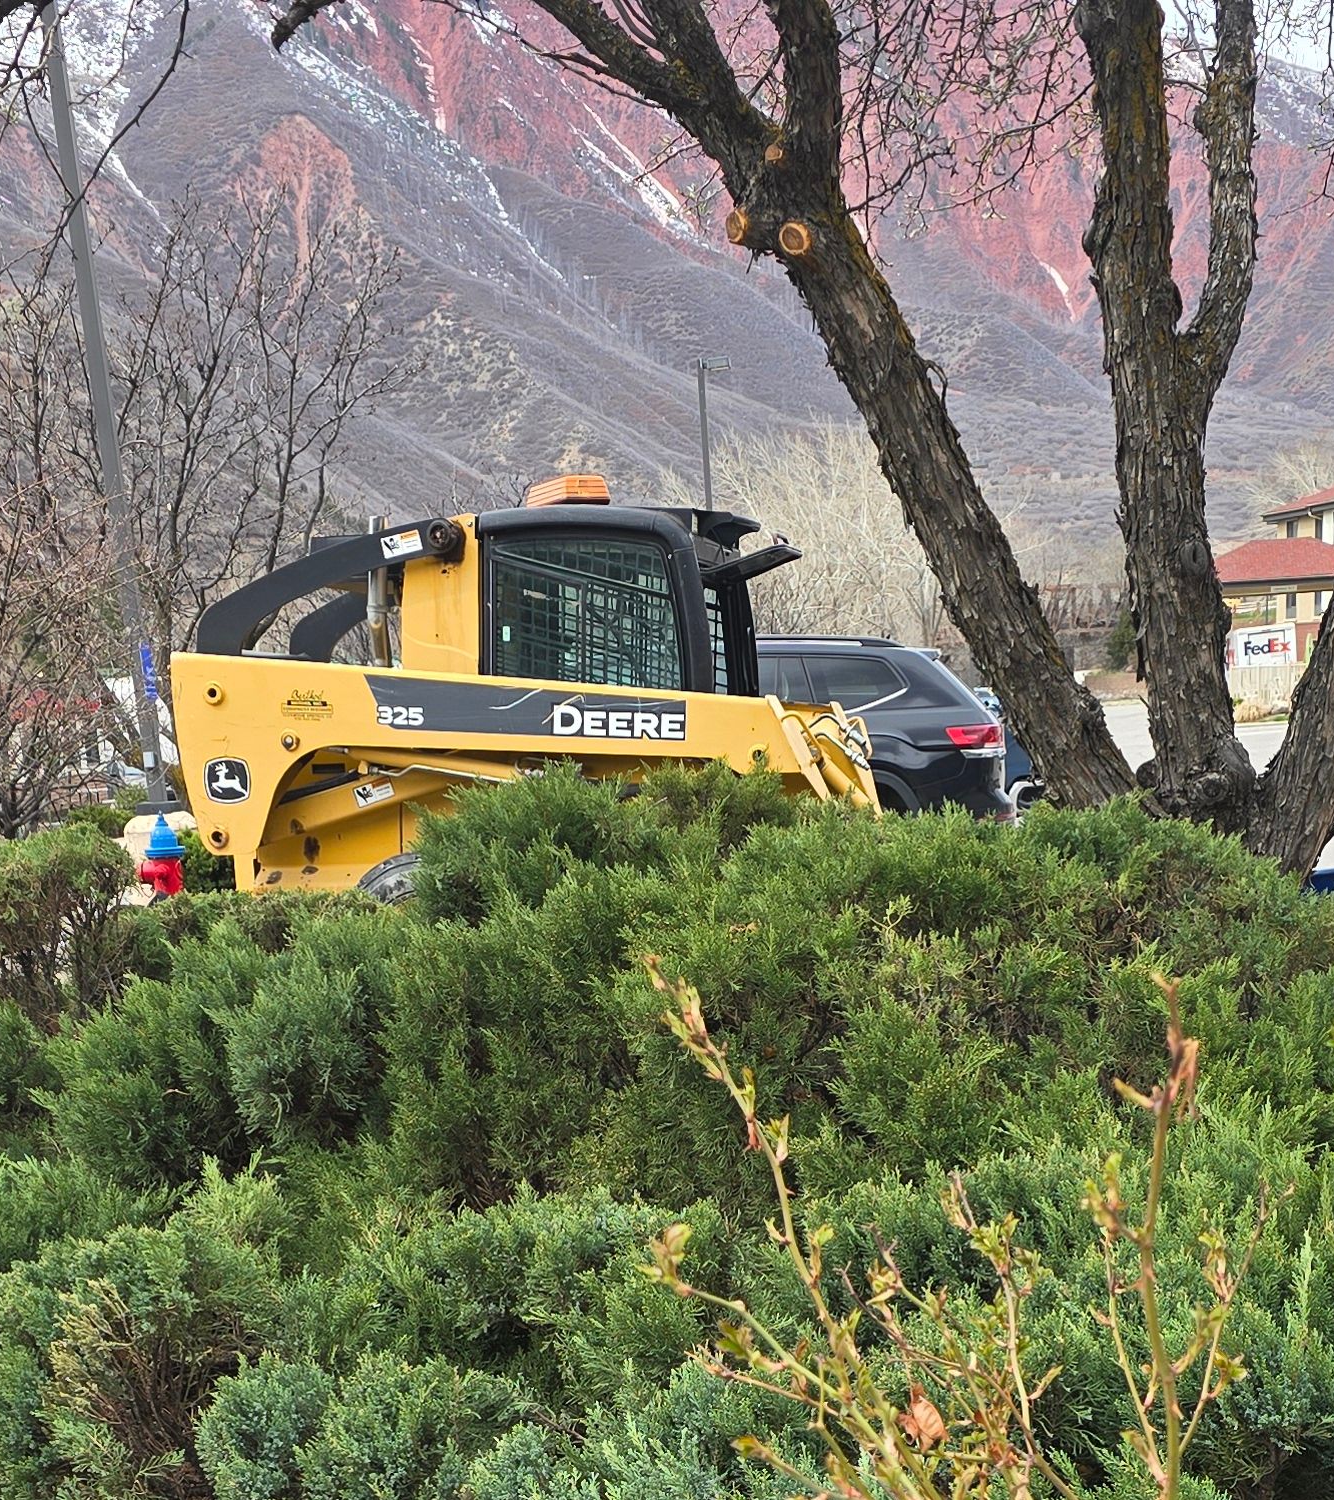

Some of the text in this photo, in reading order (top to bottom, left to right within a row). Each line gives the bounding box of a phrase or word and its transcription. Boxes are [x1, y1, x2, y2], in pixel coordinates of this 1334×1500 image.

[1243, 638, 1291, 656] FedEx
[377, 705, 425, 726] 325
[553, 704, 686, 740] DEERE
